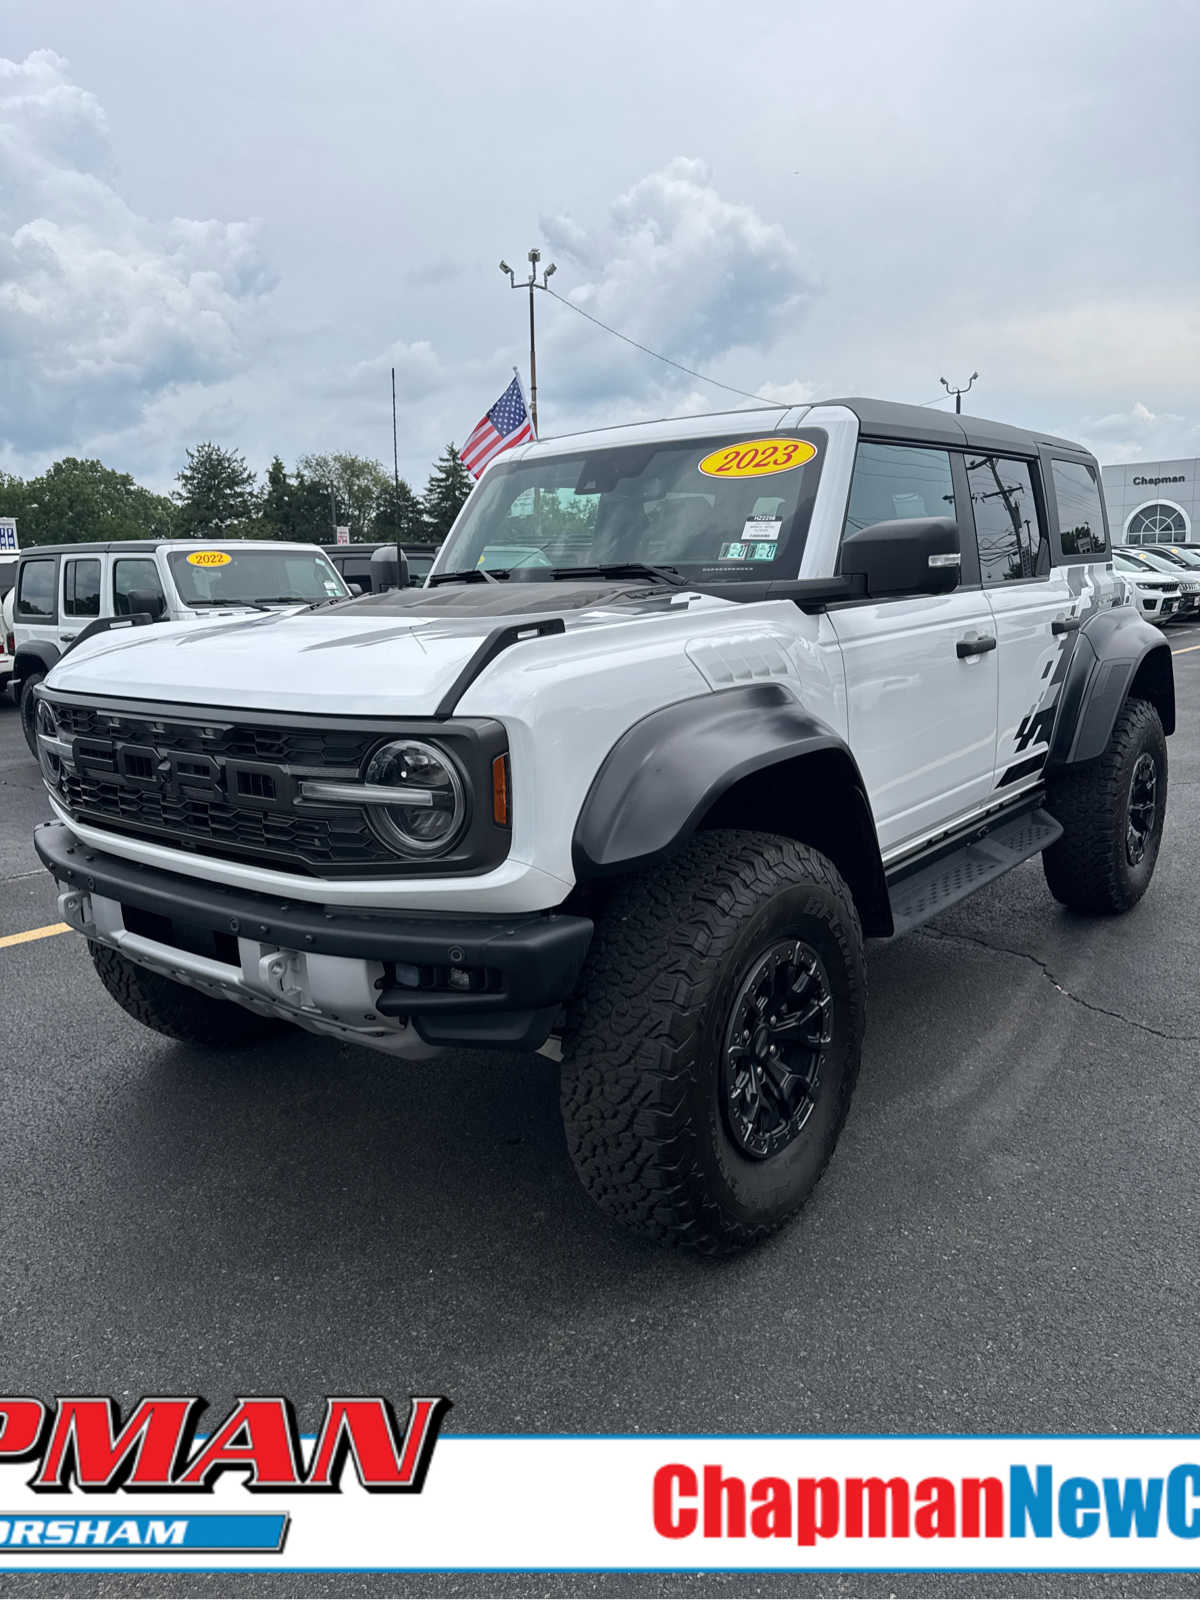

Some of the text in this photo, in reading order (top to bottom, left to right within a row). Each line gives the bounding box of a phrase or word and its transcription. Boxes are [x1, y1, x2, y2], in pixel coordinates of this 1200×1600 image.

[715, 444, 799, 473] 2023
[1133, 475, 1185, 487] Chapman
[195, 554, 225, 565] 2022
[72, 737, 292, 808] FORD
